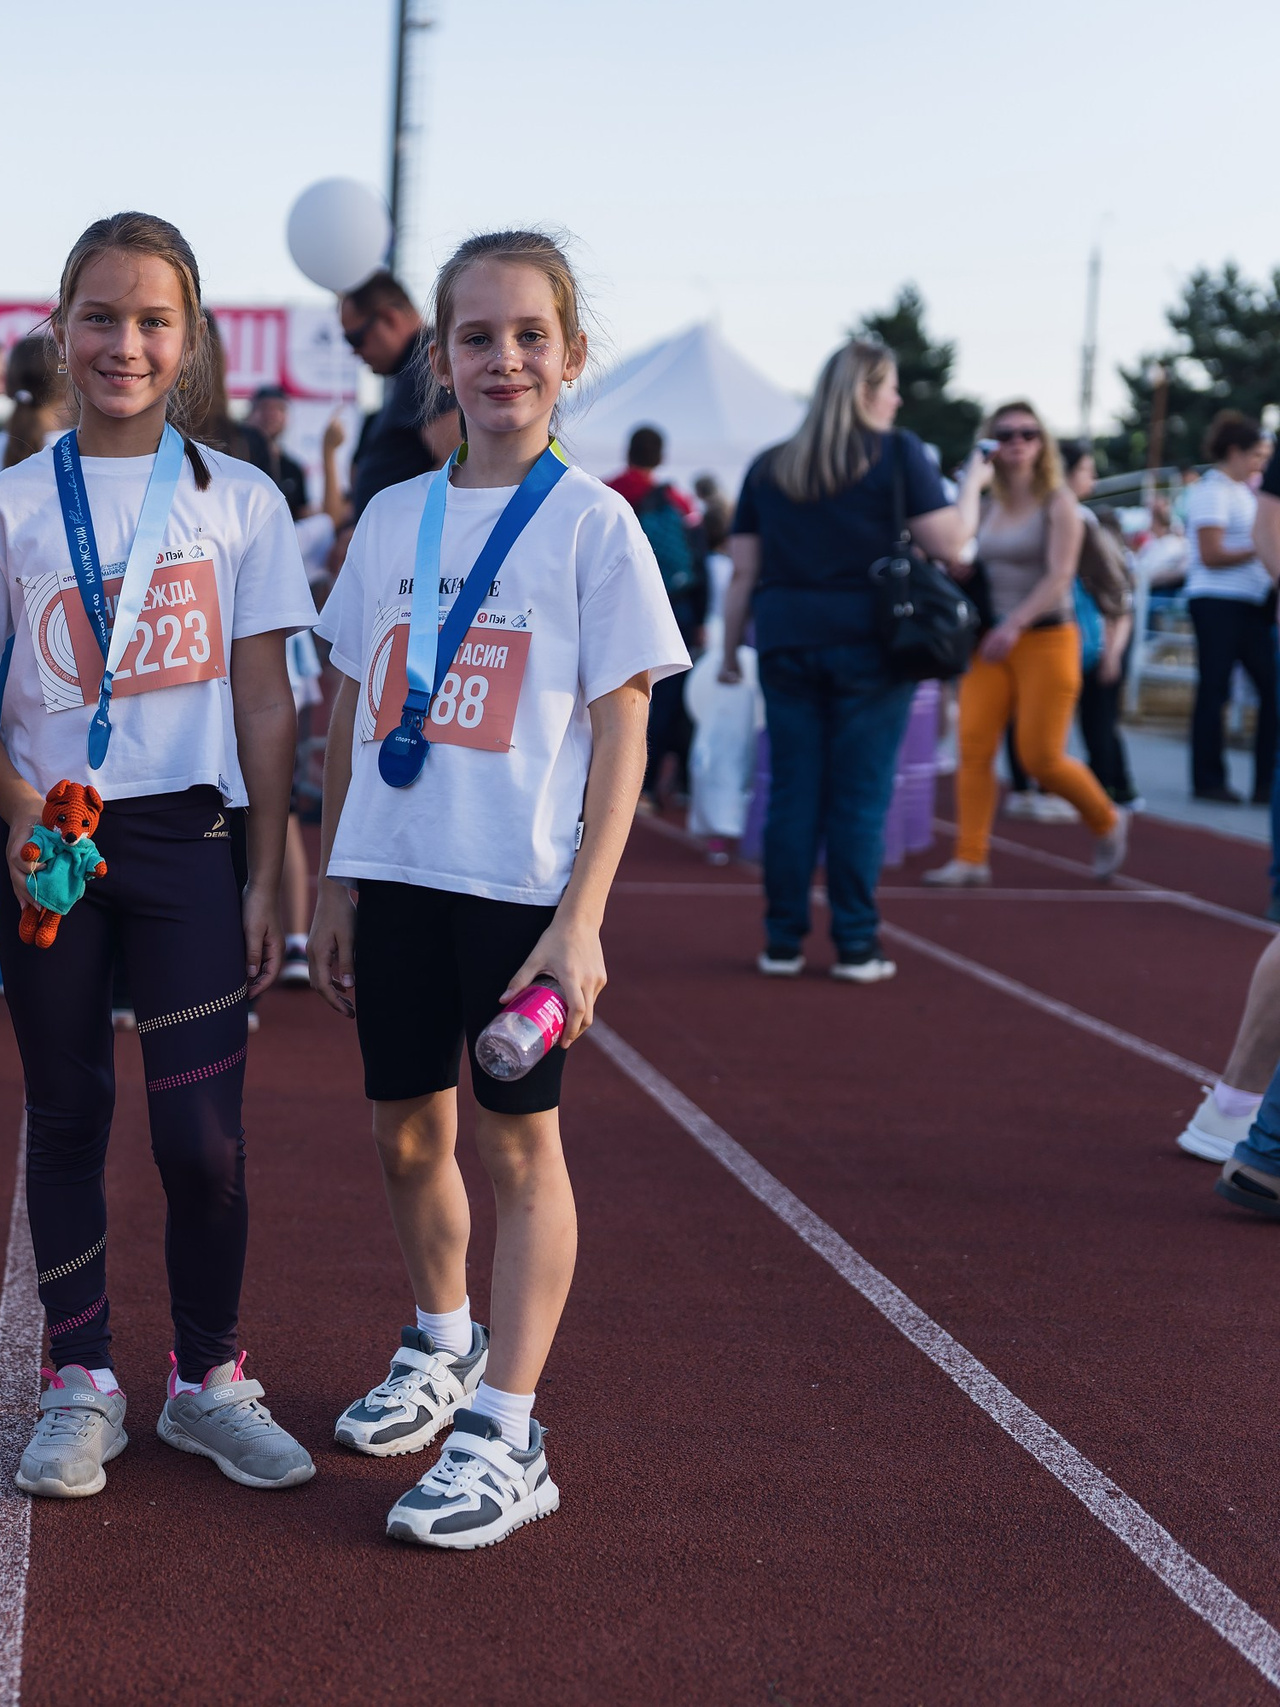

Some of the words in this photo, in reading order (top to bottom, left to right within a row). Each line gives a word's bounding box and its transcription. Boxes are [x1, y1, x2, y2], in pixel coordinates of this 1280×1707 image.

[74, 526, 96, 585] КАЛУЖСКИЙ
[165, 550, 184, 561] Пэй
[62, 575, 77, 583] СПО
[92, 593, 100, 607] 40
[488, 614, 506, 624] Пэй
[452, 642, 509, 669] ТАСИЯ
[72, 1393, 96, 1403] GSD
[213, 1388, 235, 1401] GSD
